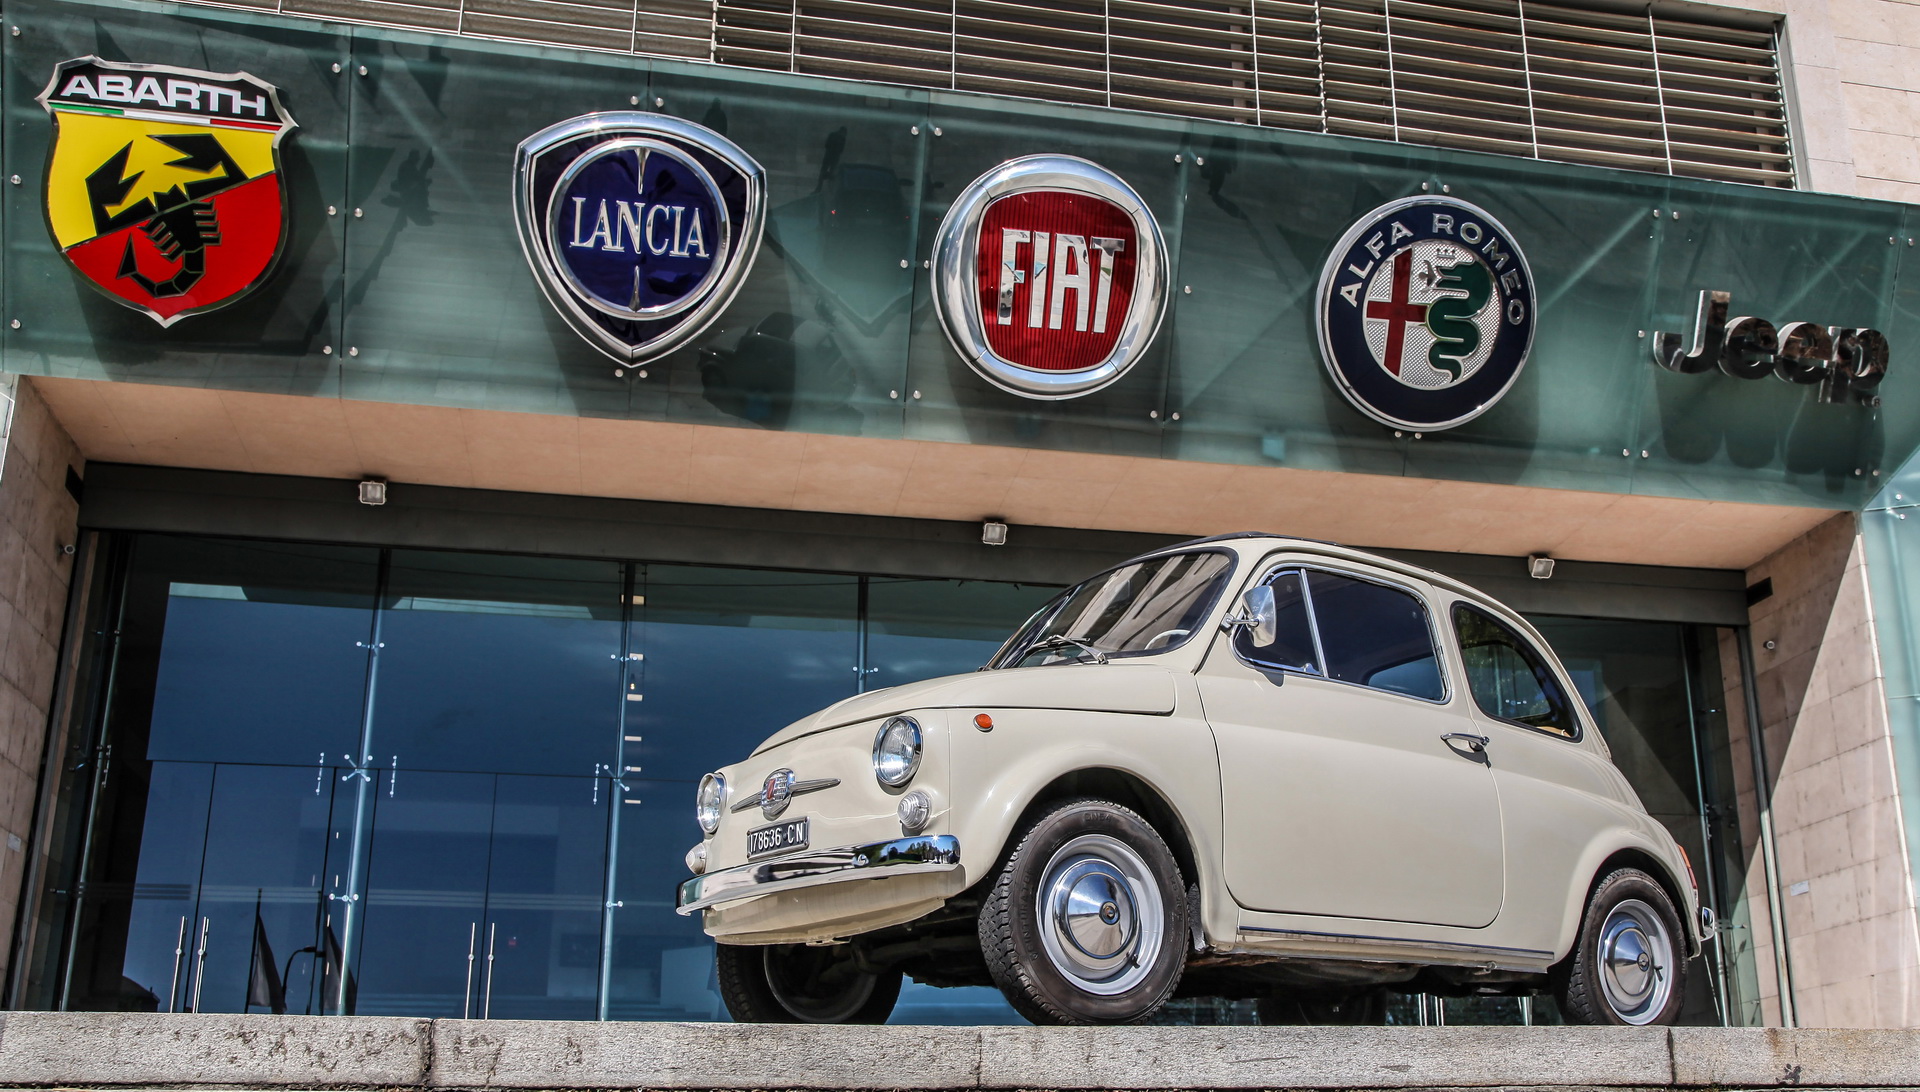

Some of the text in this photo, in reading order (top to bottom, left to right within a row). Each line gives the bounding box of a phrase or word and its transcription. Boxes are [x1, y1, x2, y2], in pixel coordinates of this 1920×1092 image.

[60, 75, 266, 117] ABARTH
[569, 196, 711, 260] LANCIA
[1339, 212, 1525, 326] ALFA ROMEO
[997, 227, 1126, 335] FIAT
[1652, 289, 1890, 404] Jeep
[750, 822, 804, 853] 178636 CN
